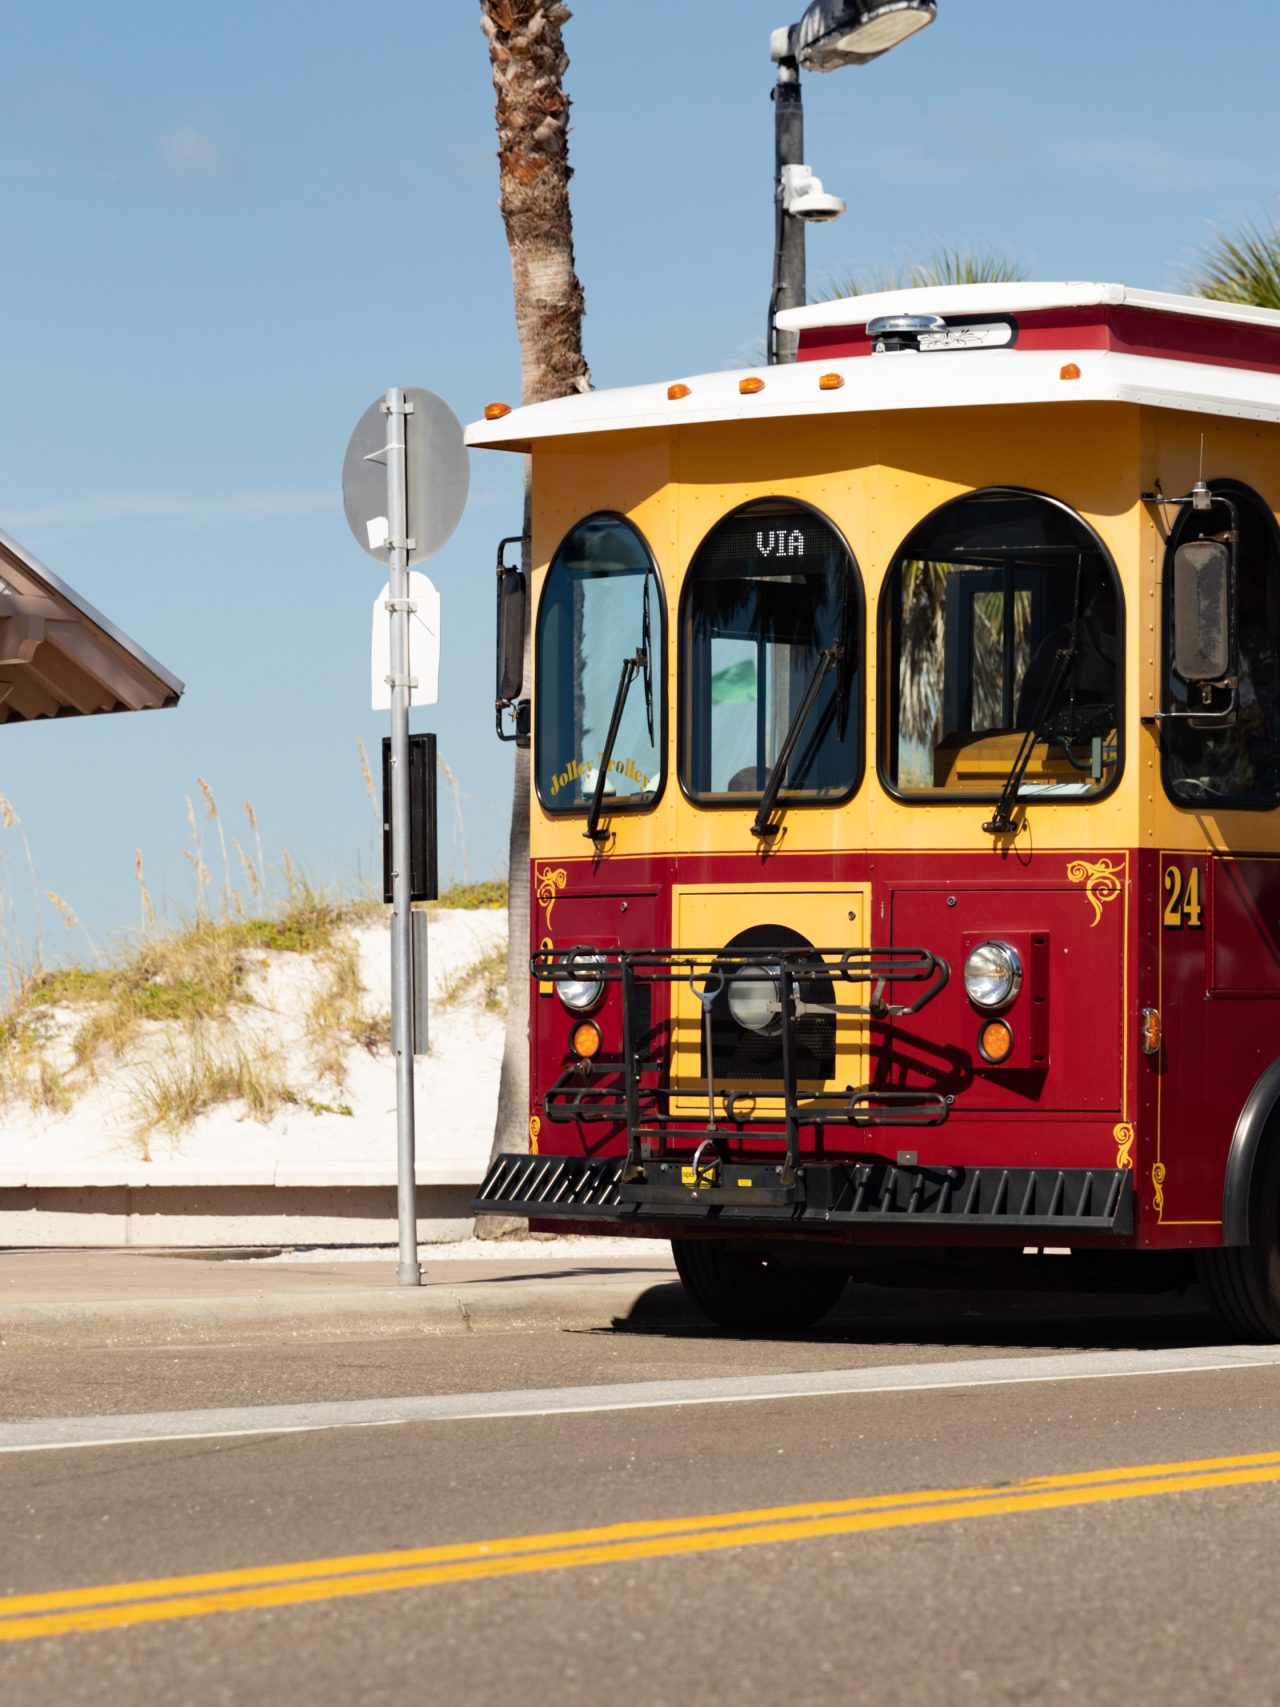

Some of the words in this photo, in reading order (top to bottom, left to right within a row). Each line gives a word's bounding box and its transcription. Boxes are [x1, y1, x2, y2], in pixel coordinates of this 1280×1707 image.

[757, 530, 803, 557] VIA
[550, 760, 592, 796] Jolley
[598, 752, 651, 792] rolley
[1164, 866, 1201, 926] 24
